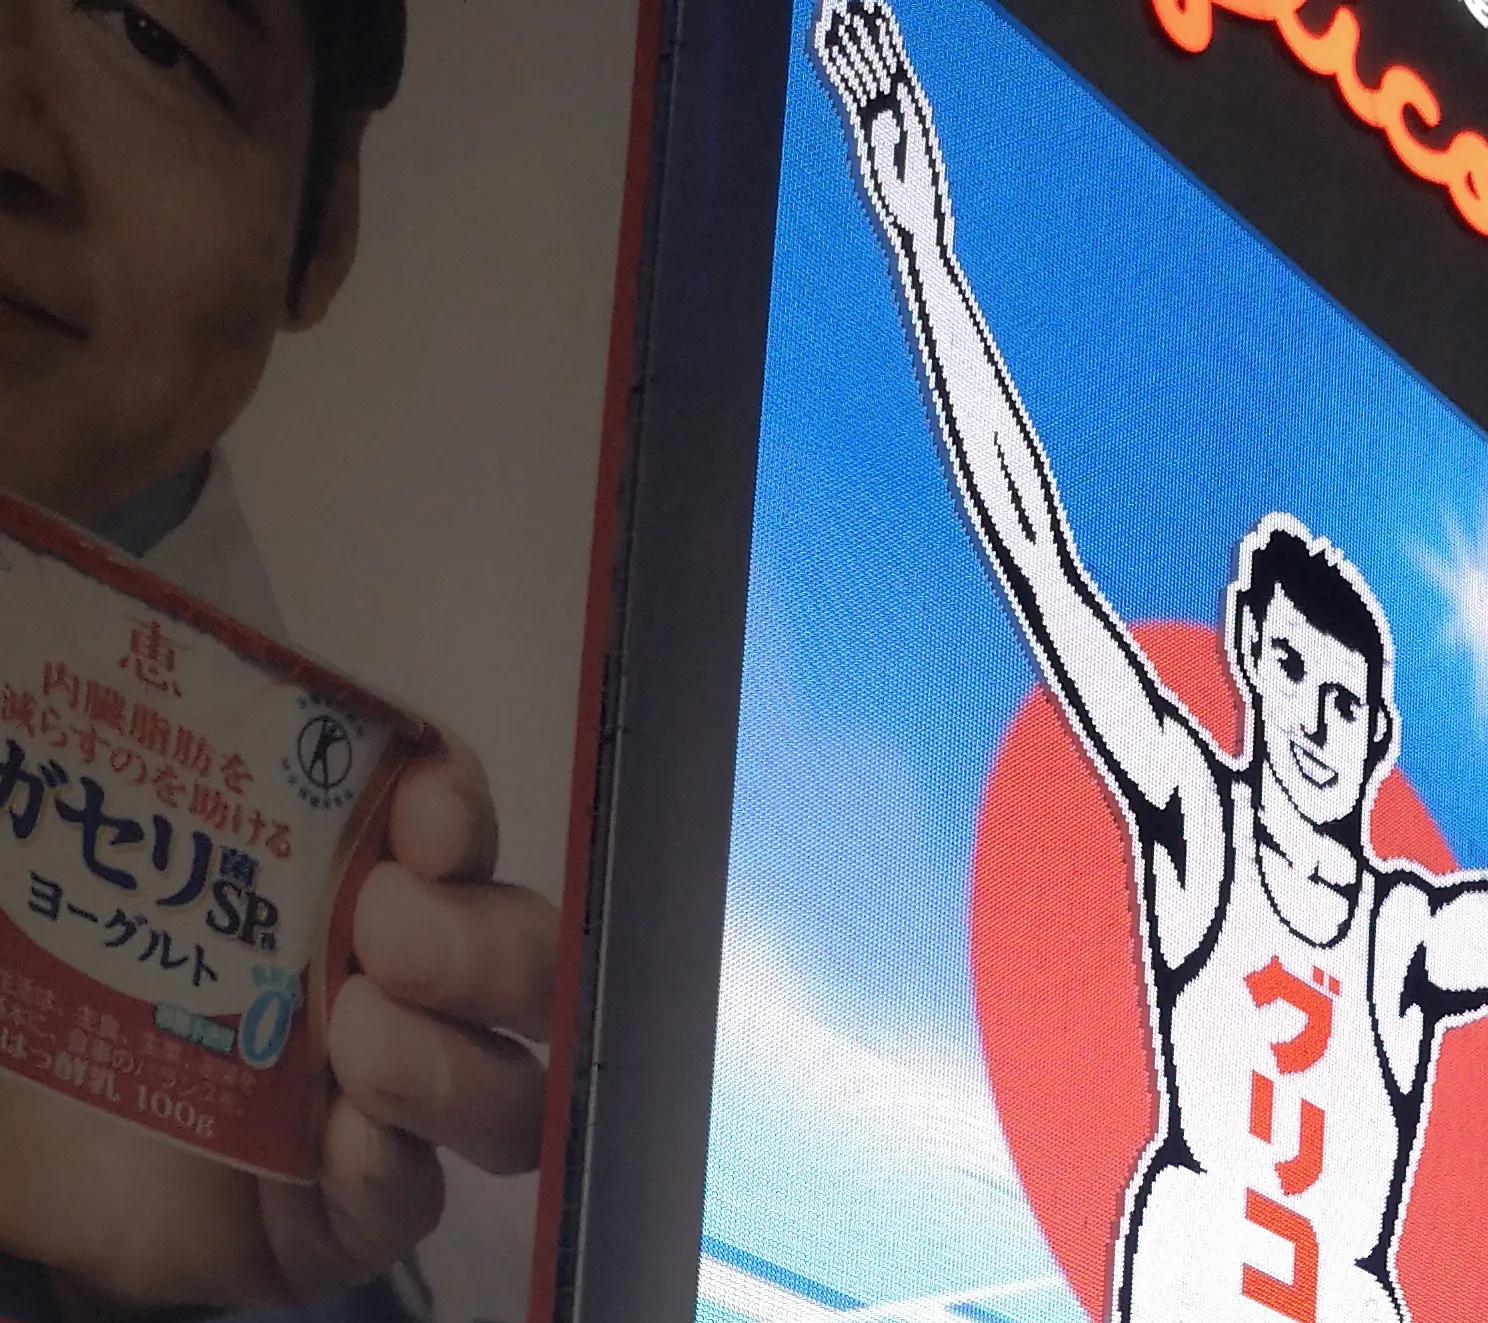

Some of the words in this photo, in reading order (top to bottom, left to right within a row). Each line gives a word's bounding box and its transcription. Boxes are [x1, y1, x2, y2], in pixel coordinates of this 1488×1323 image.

[28, 869, 219, 988] ヨーグルト
